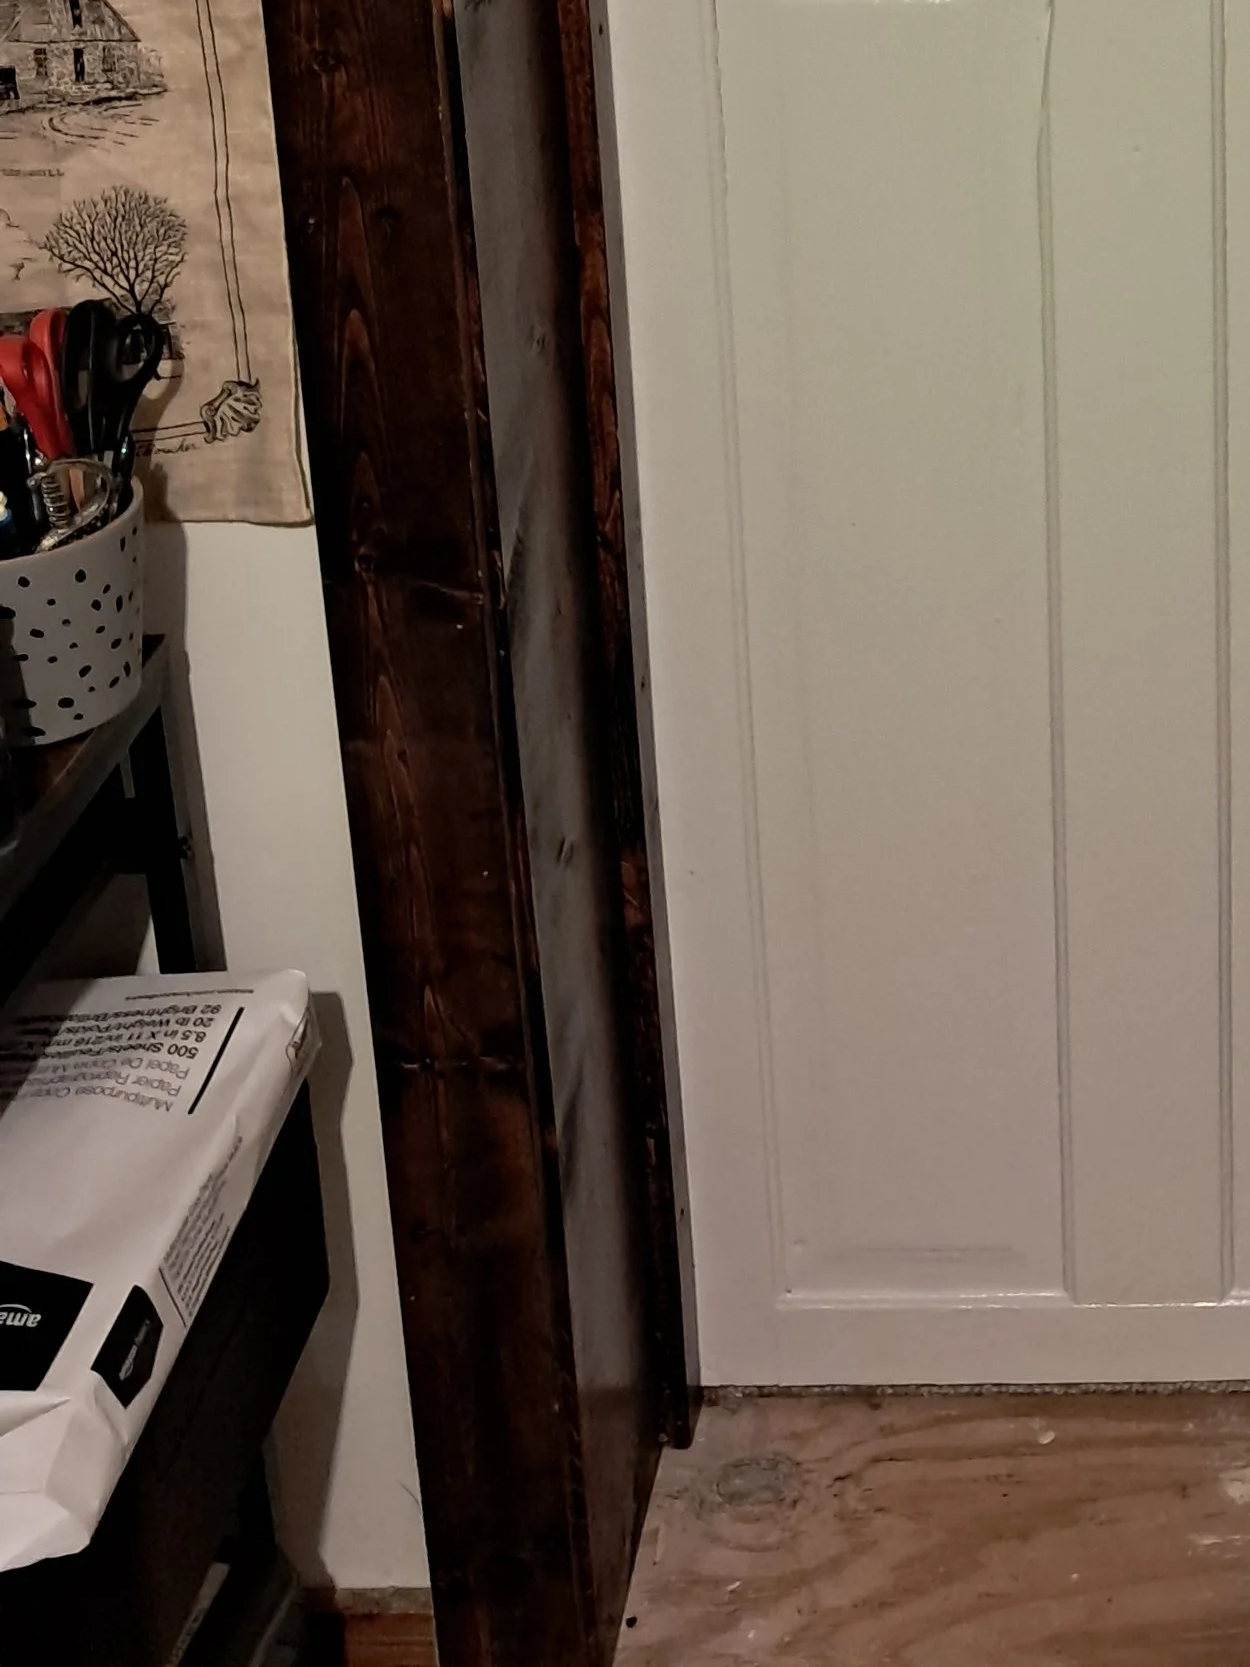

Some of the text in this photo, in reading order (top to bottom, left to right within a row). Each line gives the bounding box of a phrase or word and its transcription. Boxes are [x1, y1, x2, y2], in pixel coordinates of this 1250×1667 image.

[203, 1004, 222, 1015] 92
[175, 1017, 190, 1026] lb
[193, 1017, 214, 1027] 20
[127, 1032, 143, 1041] 11
[148, 1030, 157, 1039] X
[164, 1030, 179, 1039] in
[181, 1030, 207, 1040] 8.5
[167, 1043, 199, 1059] 500
[120, 1057, 143, 1069] De
[144, 1058, 190, 1079] Papel
[133, 1075, 182, 1097] Papier
[76, 1085, 174, 1112] Multipurpose
